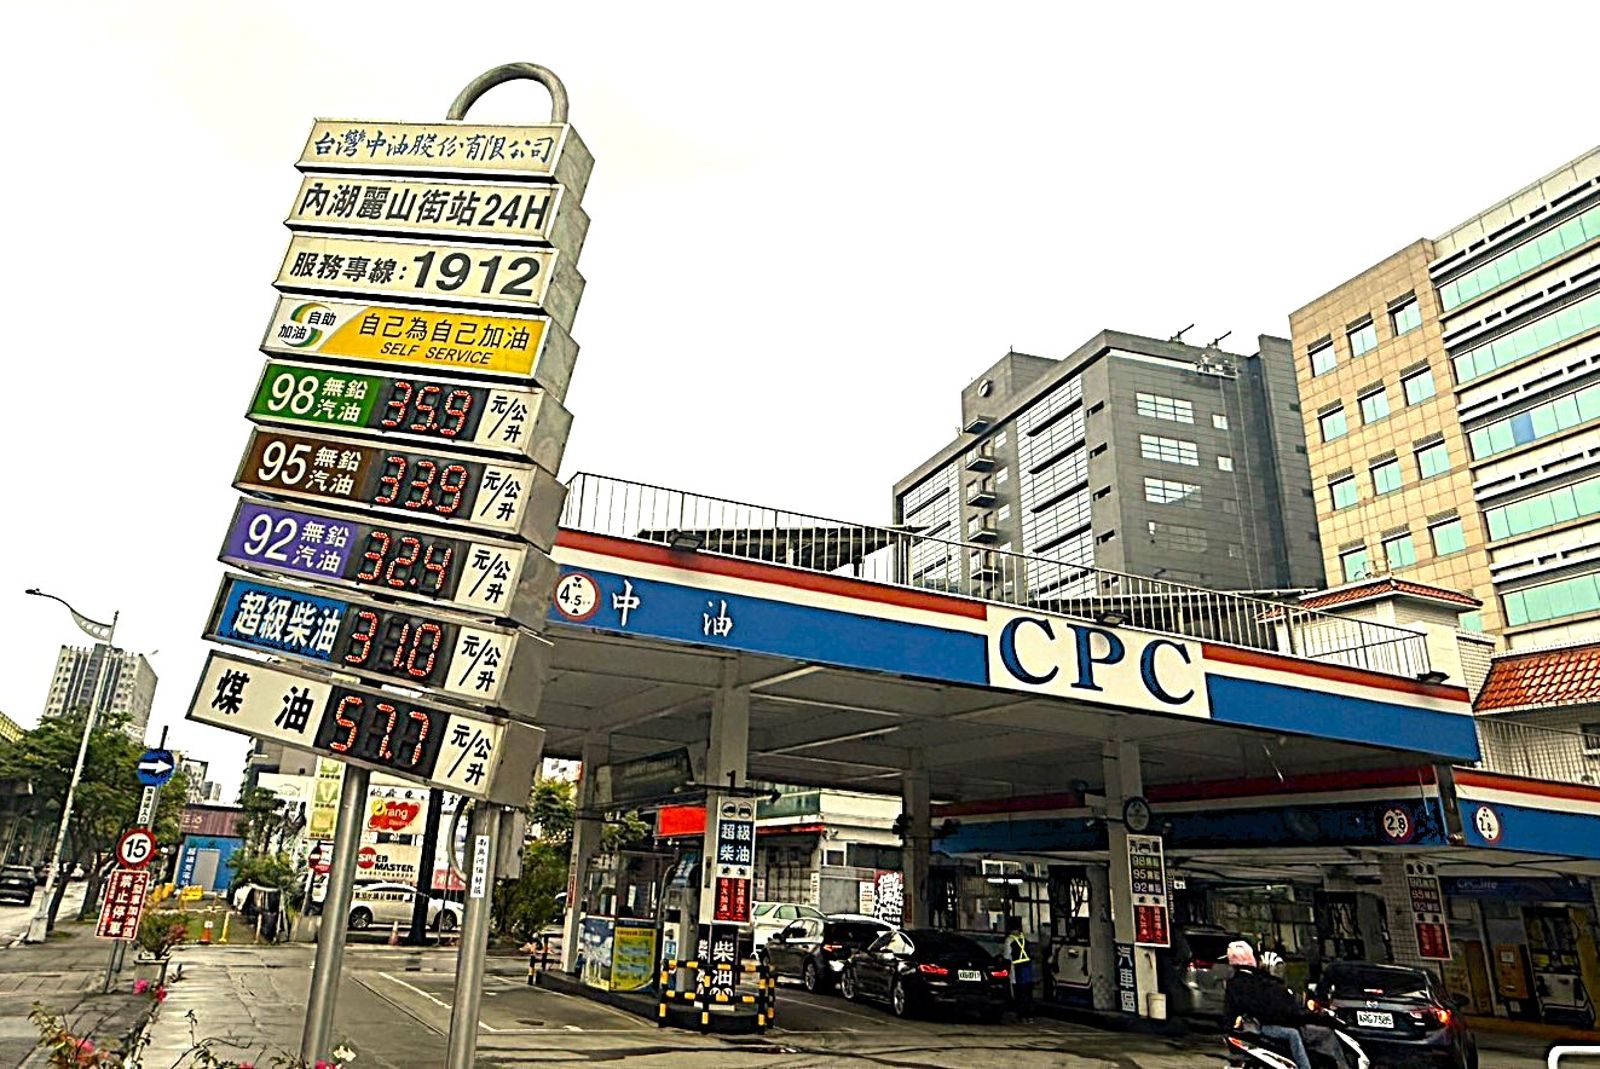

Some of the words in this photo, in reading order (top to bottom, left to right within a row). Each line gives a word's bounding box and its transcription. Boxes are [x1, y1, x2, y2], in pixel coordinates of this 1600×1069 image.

[314, 129, 555, 164] 台灣中油股份有限公司
[298, 182, 551, 230] 內湖麗山街站24H
[277, 324, 307, 341] 加油
[307, 311, 337, 326] 自助
[360, 312, 531, 351] 自己為自己加油
[380, 341, 418, 357] SELF
[424, 346, 494, 365] SERVICE
[267, 372, 319, 416] 98
[322, 376, 369, 400] 無鉛
[381, 381, 475, 437] 35.9
[314, 398, 361, 423] 汽油
[257, 441, 311, 486] 95
[314, 446, 363, 472] 無鉛
[374, 456, 467, 513] 33.9
[304, 469, 354, 496] 汽油
[243, 514, 297, 561] 92
[302, 520, 350, 545] 無鉛
[357, 530, 453, 590] 32.4
[294, 544, 342, 573] 汽油
[232, 592, 341, 652] 超級柴油
[999, 616, 1195, 705] CPC
[721, 823, 750, 841] 超級
[126, 838, 148, 859] 15
[720, 843, 750, 863] 柴油
[107, 874, 133, 935] 禁止停車
